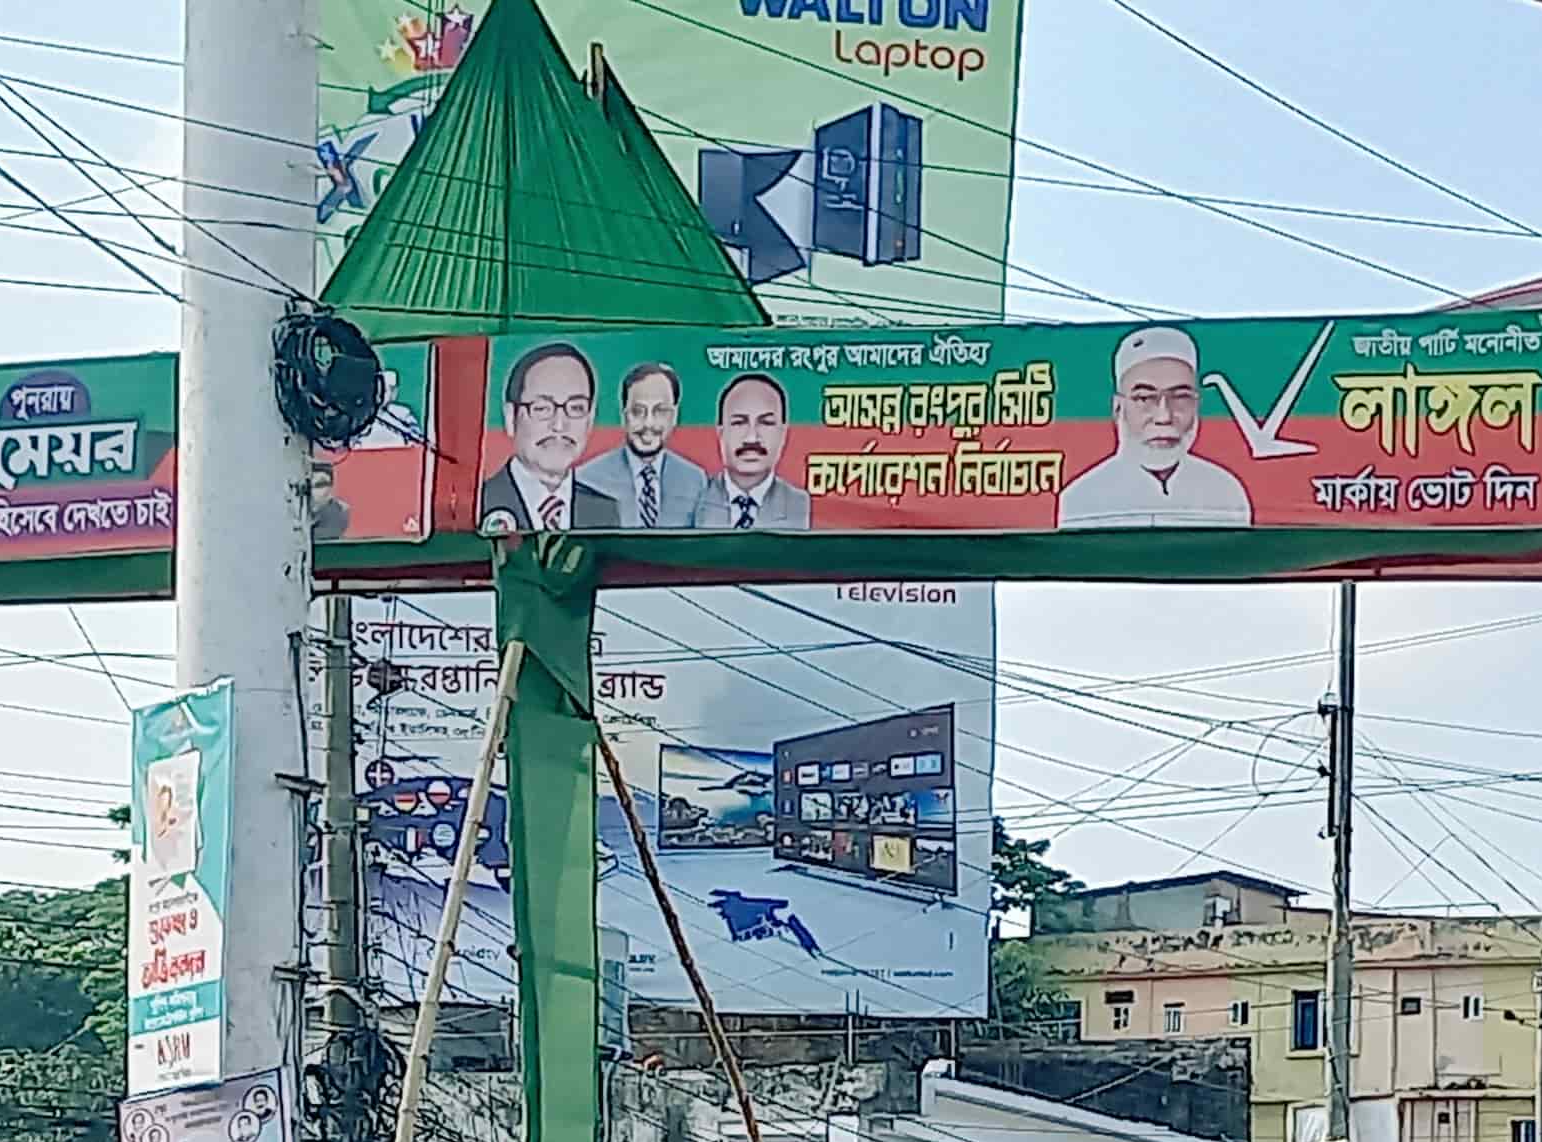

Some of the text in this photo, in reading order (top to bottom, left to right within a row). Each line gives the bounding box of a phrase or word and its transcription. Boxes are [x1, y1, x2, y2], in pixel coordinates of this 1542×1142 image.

[834, 29, 985, 81] Laptop
[706, 345, 783, 369] আমাদের
[789, 345, 839, 373] রংপুর
[843, 342, 921, 367] আমাদের
[1352, 329, 1412, 356] জাতীয়
[1418, 330, 1458, 355] পার্টি
[9, 384, 77, 423] পুনরায়
[908, 382, 988, 438] রংপুর
[993, 362, 1055, 427] সিটি
[954, 438, 1063, 498] নির্বাচনে
[1311, 462, 1539, 512] মার্কায় ভোট দিন
[63, 496, 131, 533] দেখতে
[134, 491, 174, 528] চাই
[835, 583, 957, 604] Television
[596, 671, 667, 700] ব্র্যান্ড
